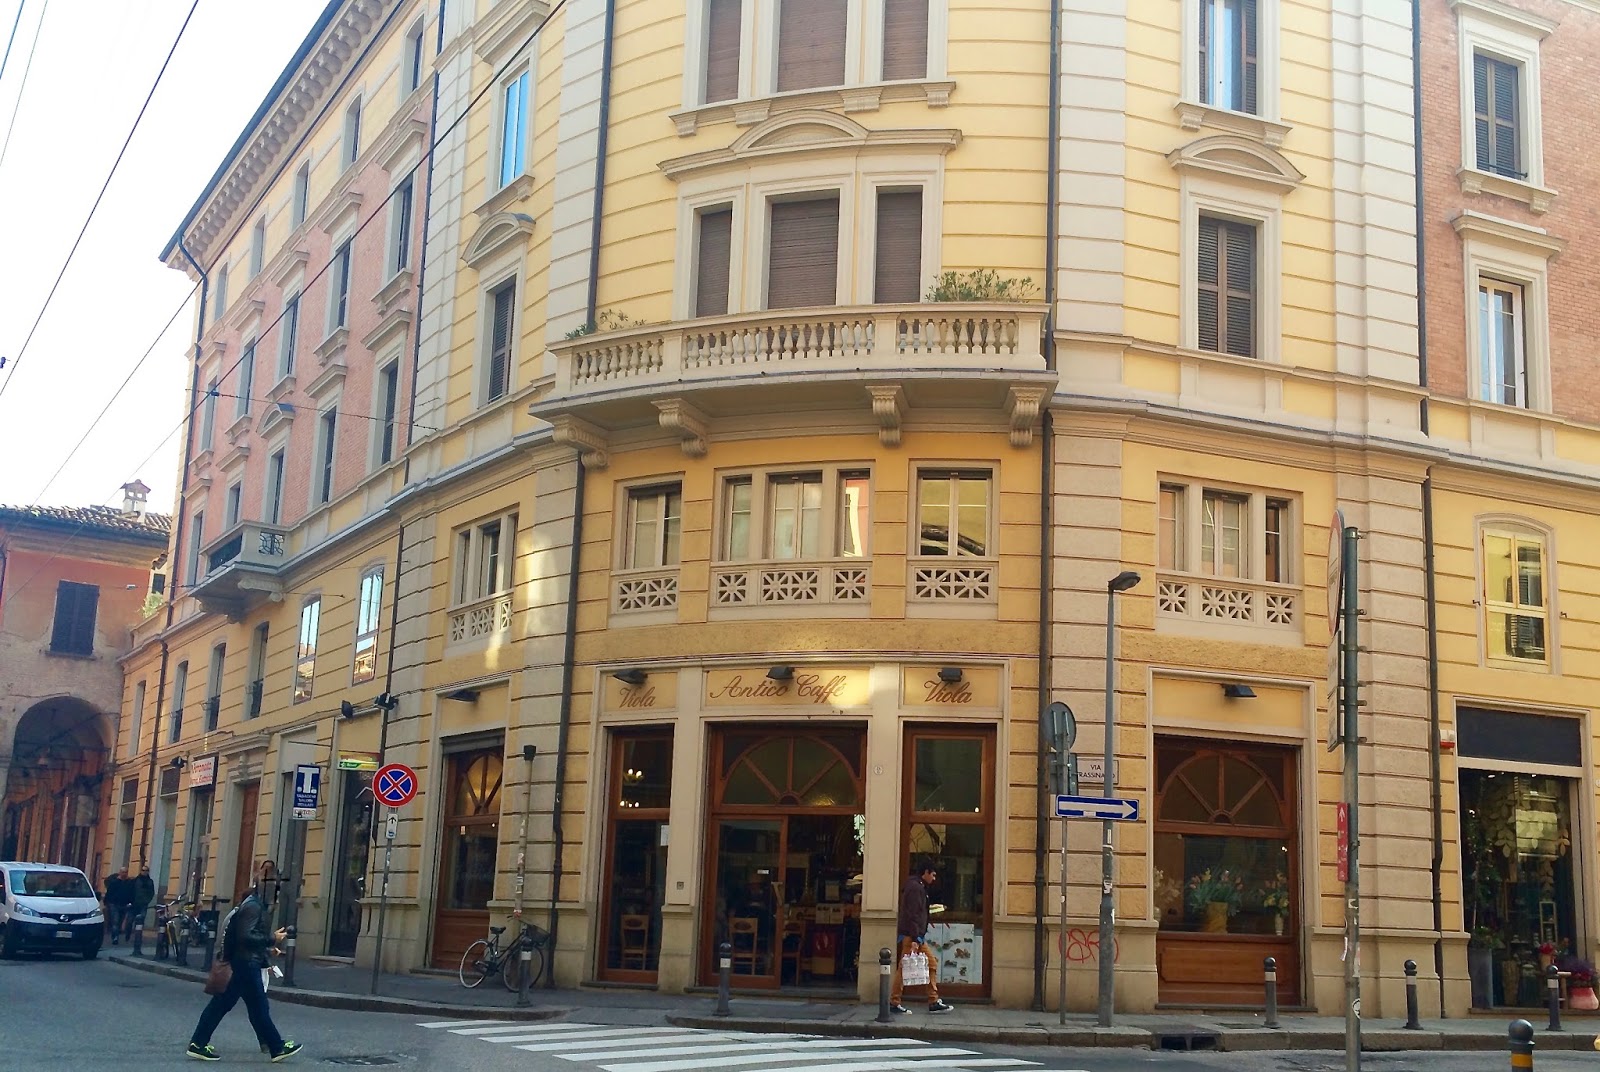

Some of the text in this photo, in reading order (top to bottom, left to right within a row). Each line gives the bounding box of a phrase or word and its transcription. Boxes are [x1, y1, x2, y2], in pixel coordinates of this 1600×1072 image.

[619, 686, 656, 708] Viola
[710, 675, 788, 699] Antico
[924, 680, 972, 703] Viola
